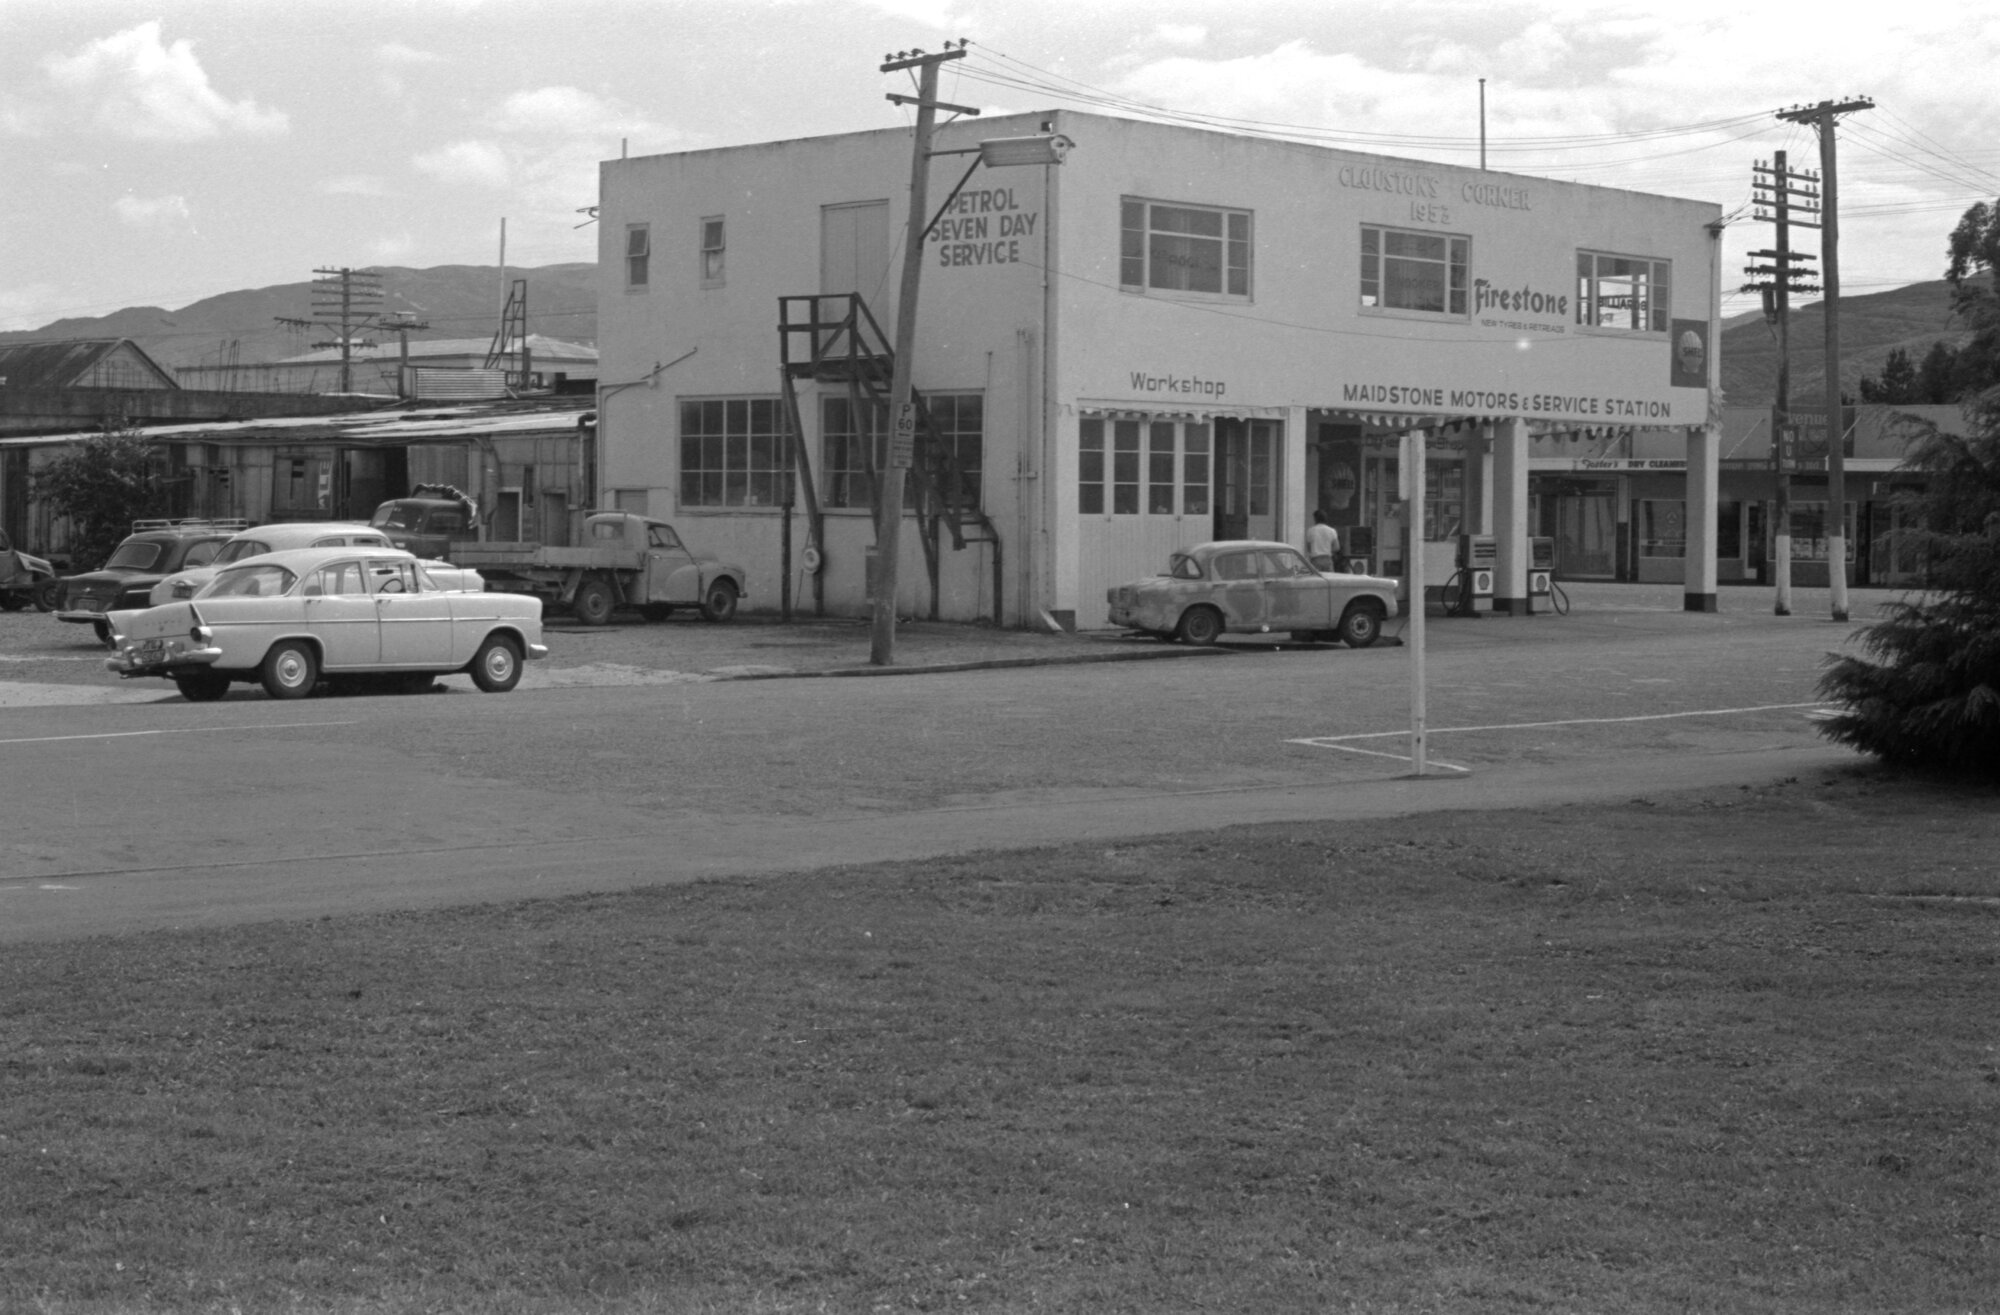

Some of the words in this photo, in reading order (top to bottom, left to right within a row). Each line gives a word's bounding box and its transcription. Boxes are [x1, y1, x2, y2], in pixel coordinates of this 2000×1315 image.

[948, 188, 1020, 215] PETROL
[1461, 181, 1532, 212] CORNER
[929, 216, 989, 243] SEVEN
[1000, 212, 1038, 238] DAY
[939, 240, 1020, 268] SERVICE
[1474, 278, 1569, 316] Firestone
[1130, 371, 1226, 399] Workshop
[902, 404, 911, 417] P
[1343, 383, 1444, 407] MAIDSTONE
[1450, 390, 1520, 411] MOTORS
[1533, 394, 1600, 415] SERVICE
[1605, 398, 1672, 420] STATION
[898, 418, 913, 430] 60
